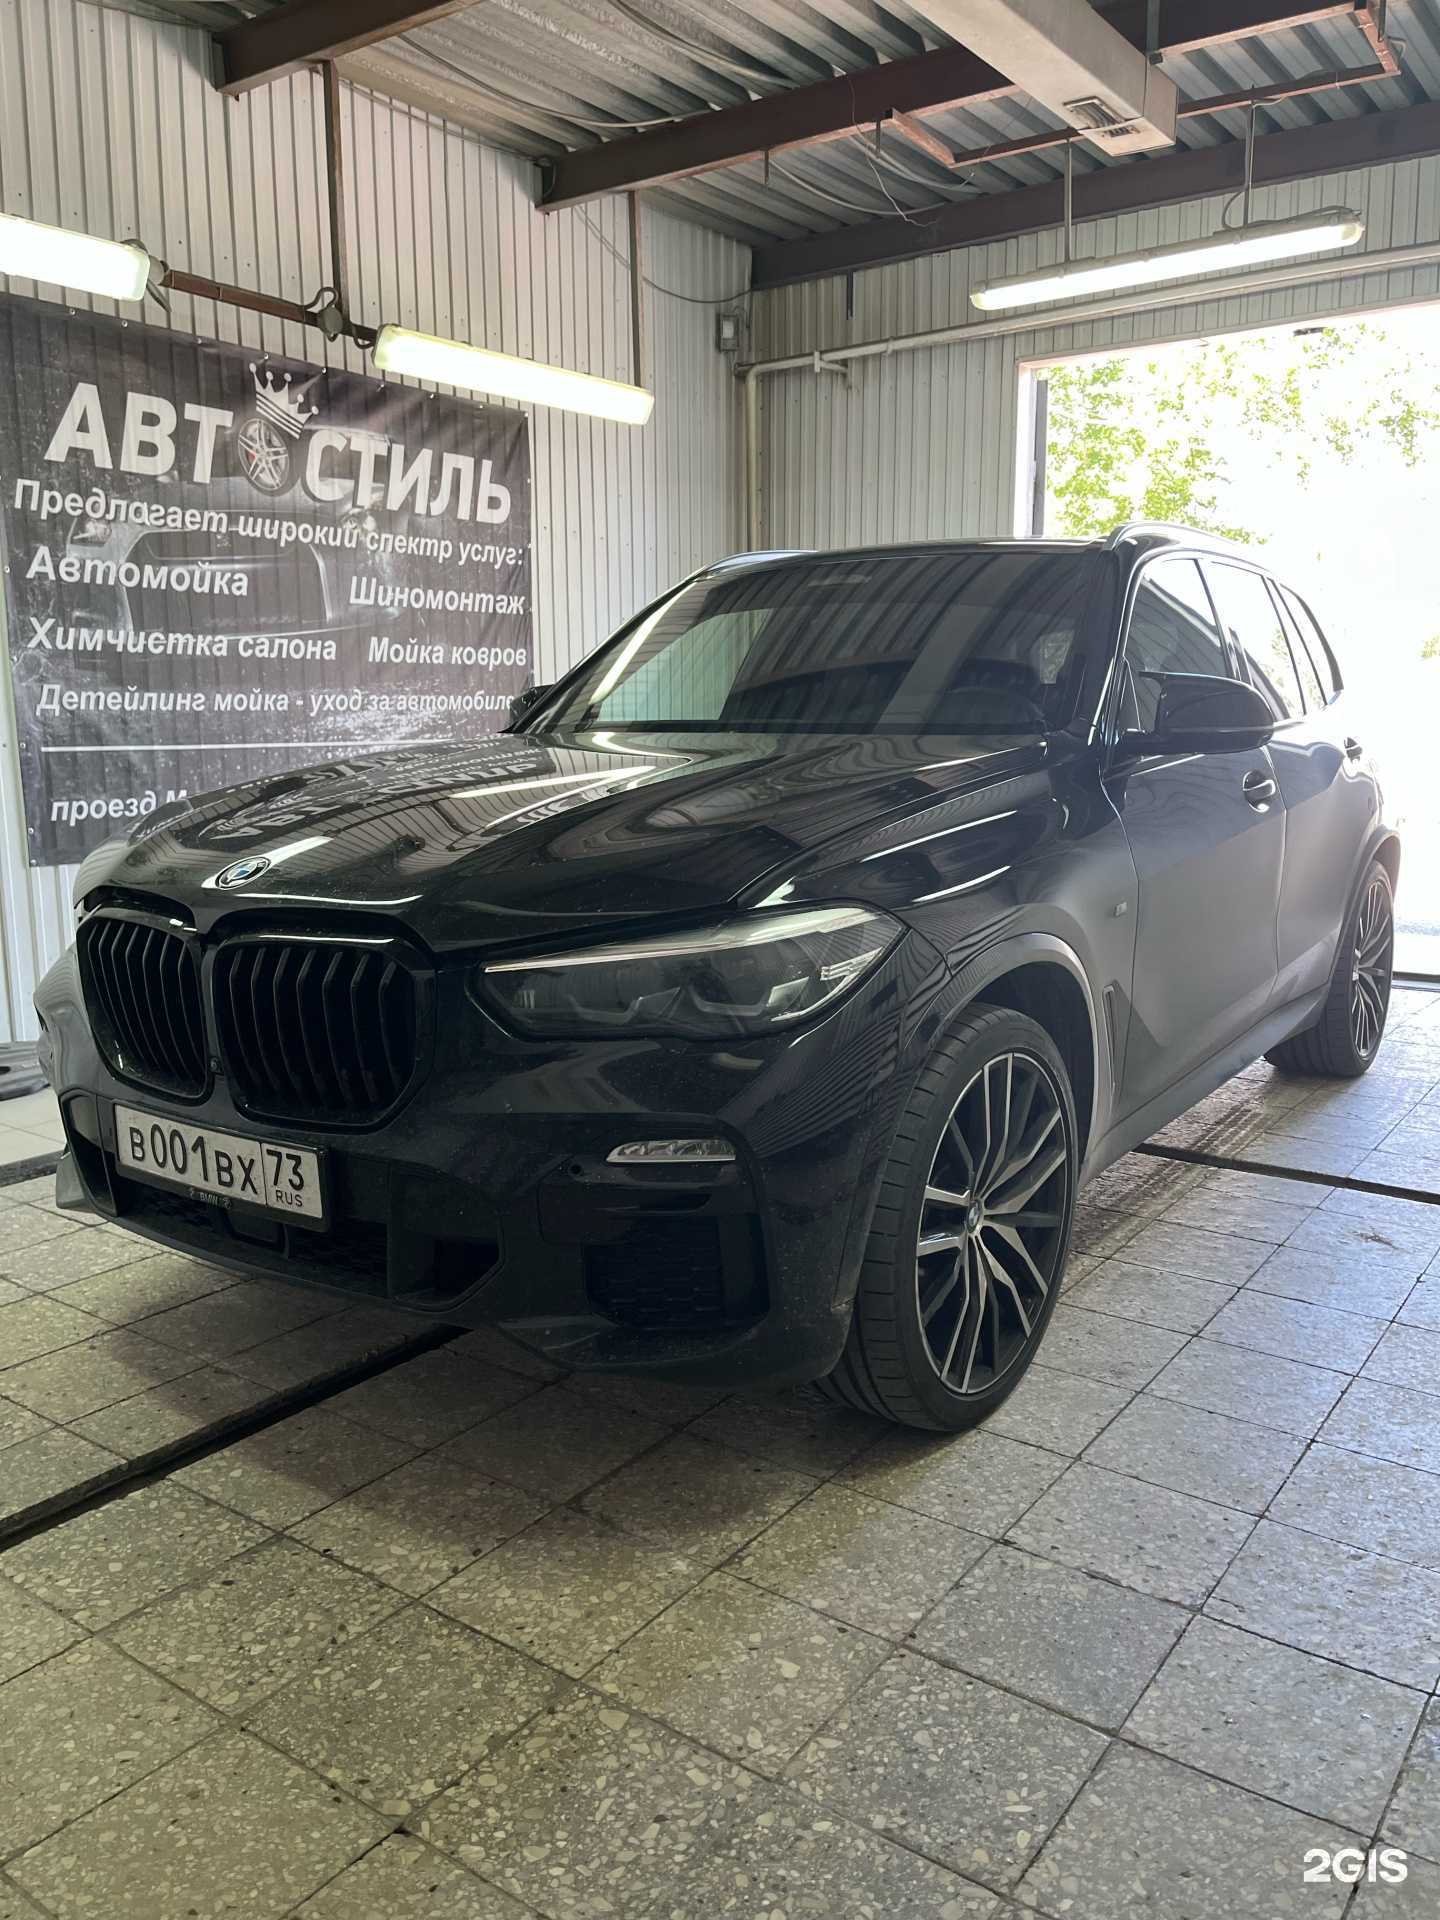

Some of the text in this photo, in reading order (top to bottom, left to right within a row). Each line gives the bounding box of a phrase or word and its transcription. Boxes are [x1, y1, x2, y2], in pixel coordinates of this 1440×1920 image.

[14, 478, 523, 569] Предлагает широкий спектр услуг:
[25, 545, 249, 597] Автомойка
[349, 575, 526, 615] Шиномонтаж
[26, 616, 337, 660] Химчистка салона
[368, 636, 527, 671] Мойка ковров
[35, 684, 206, 717] Детейлинг
[213, 687, 289, 712] мойка
[309, 689, 362, 716] уход
[367, 694, 392, 711] за
[51, 790, 157, 827] проезд
[266, 1148, 305, 1192] 73
[275, 1189, 304, 1208] RUS
